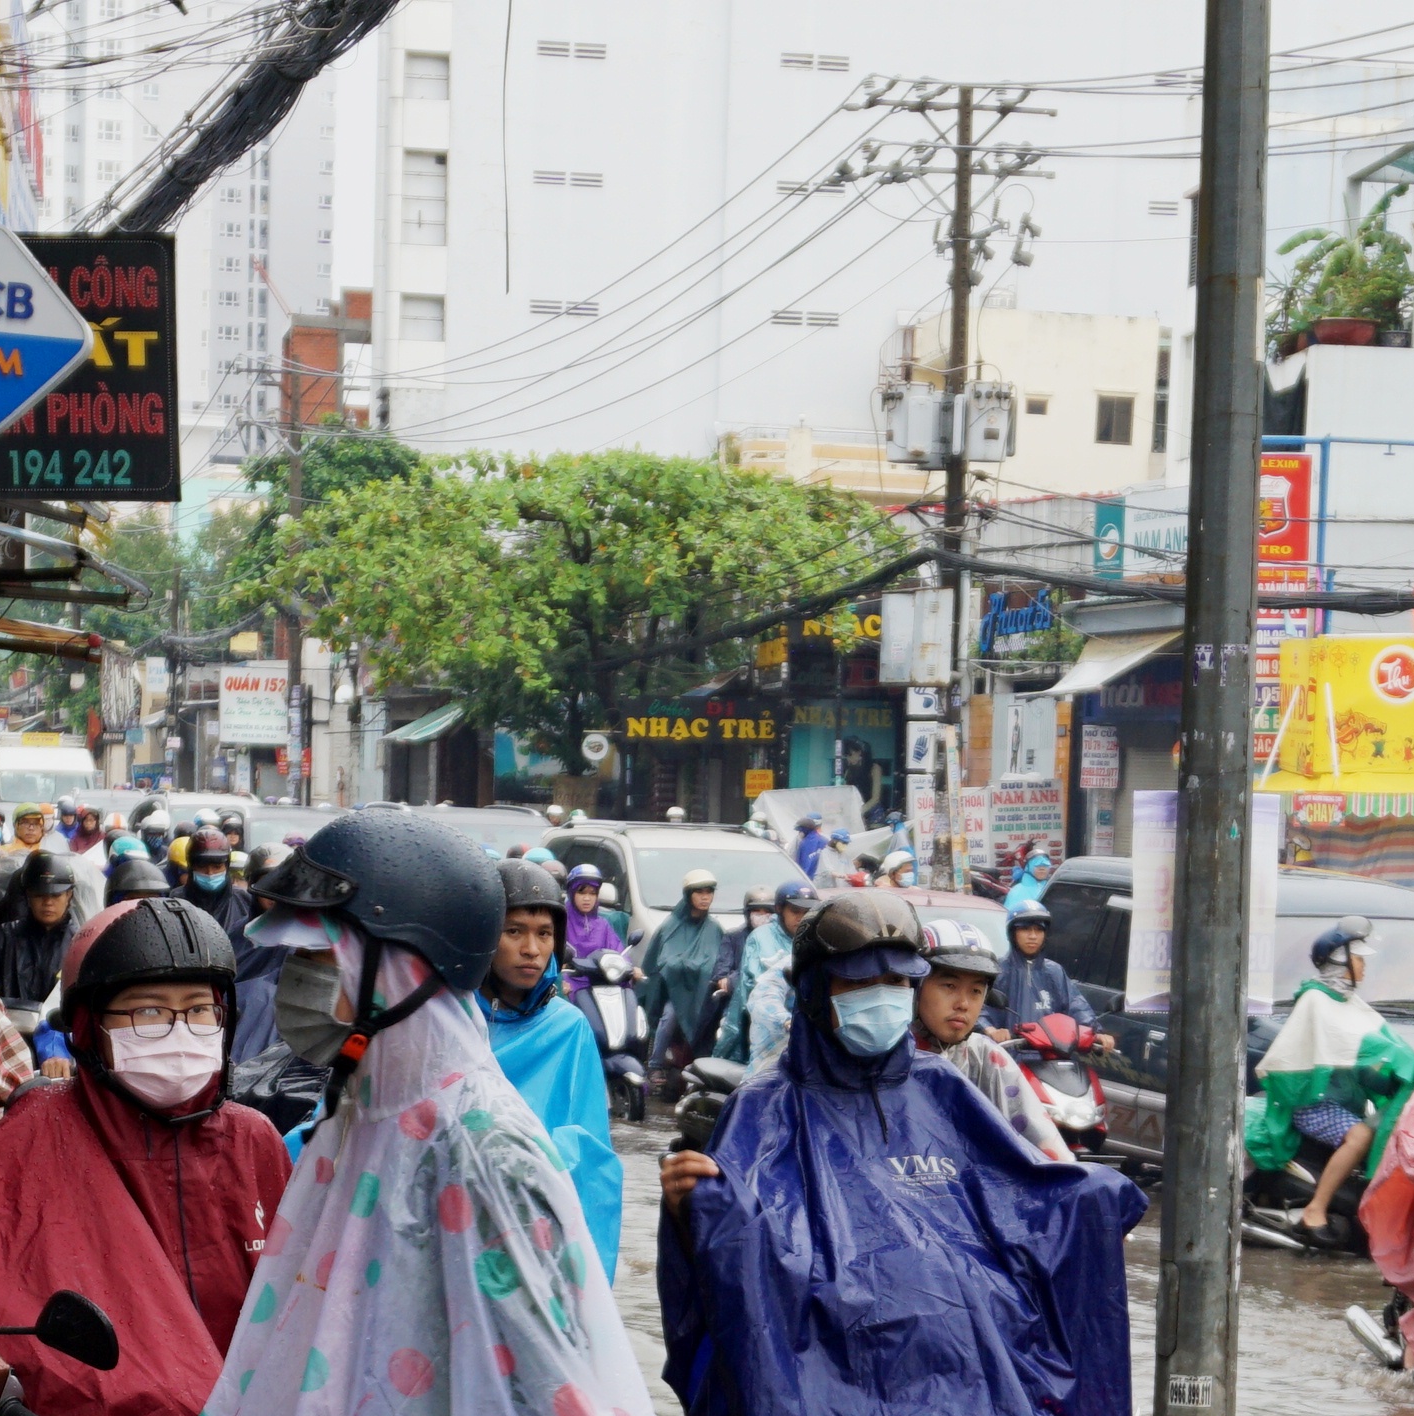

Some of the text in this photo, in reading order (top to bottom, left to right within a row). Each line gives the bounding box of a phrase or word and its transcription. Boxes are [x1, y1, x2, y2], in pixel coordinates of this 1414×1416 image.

[69, 255, 160, 308] CÔNG
[47, 382, 165, 436] PHÒNG
[10, 450, 63, 486] 194
[74, 450, 132, 486] 242
[225, 673, 260, 692] QUÁN
[626, 710, 775, 741] NHẠC TRẺ
[993, 790, 1060, 805] NAM ANH
[887, 1154, 957, 1177] VMS
